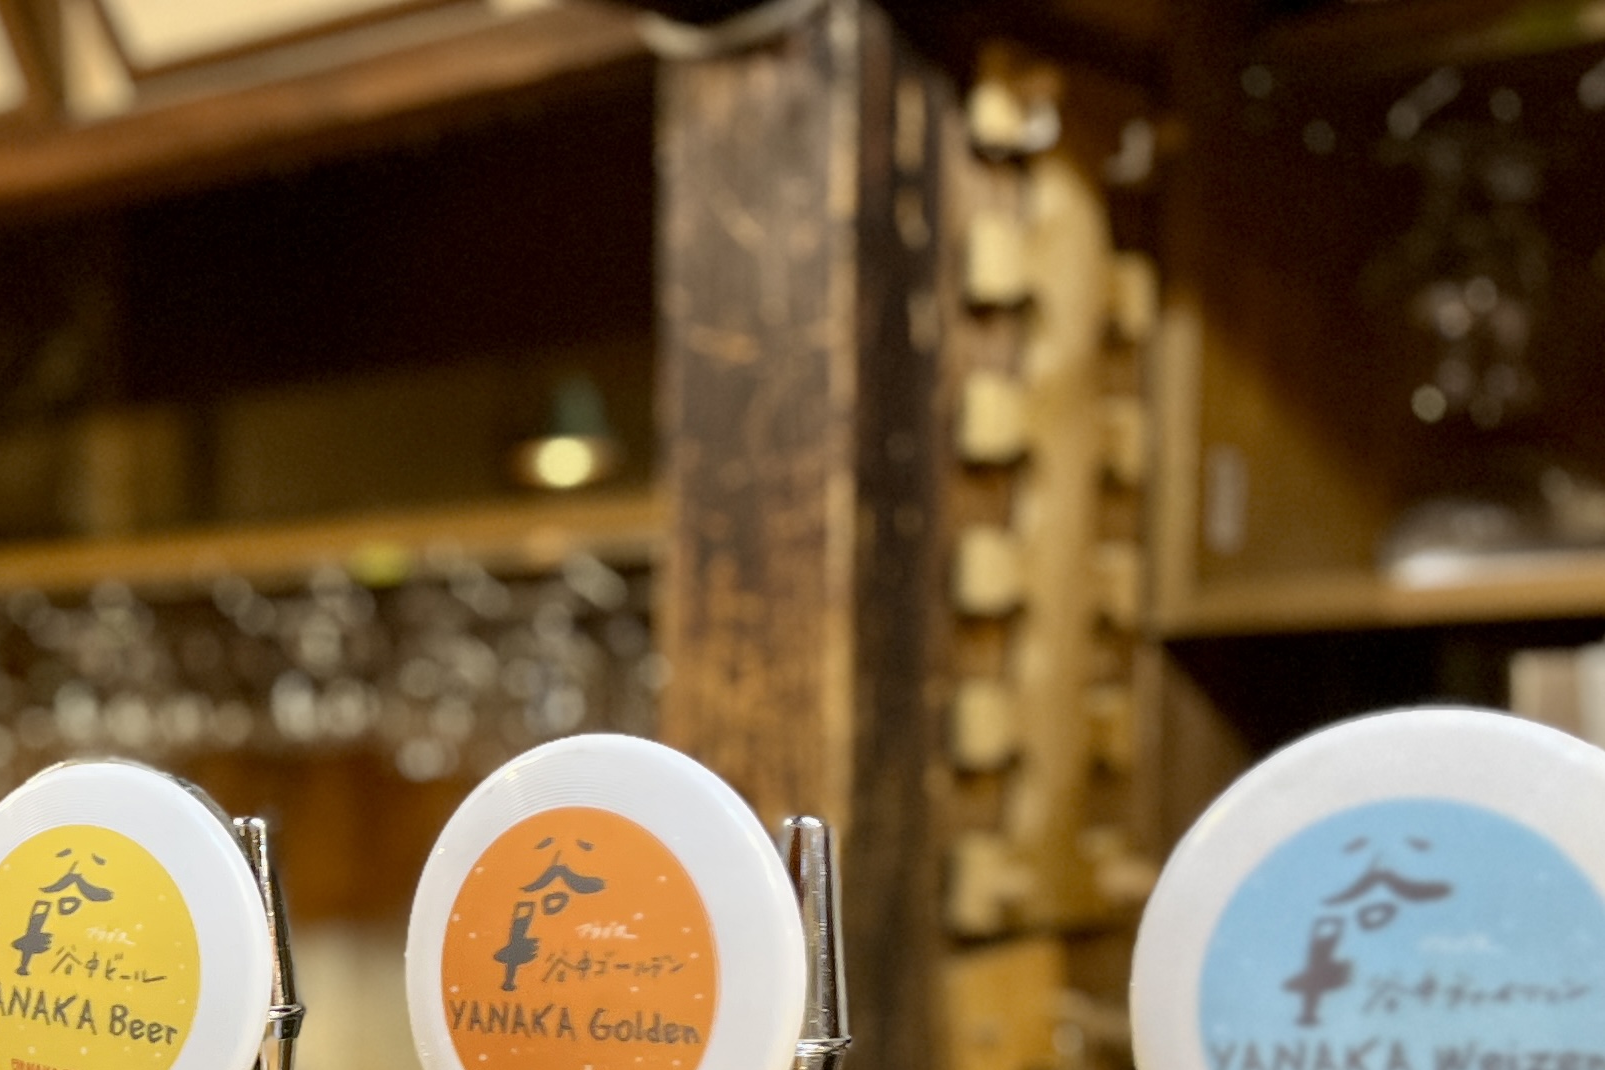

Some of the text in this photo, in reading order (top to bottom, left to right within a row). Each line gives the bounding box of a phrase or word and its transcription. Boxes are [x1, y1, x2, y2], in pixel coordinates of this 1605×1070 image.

[108, 1003, 180, 1046] Beer
[448, 999, 702, 1045] YANAKA Golden
